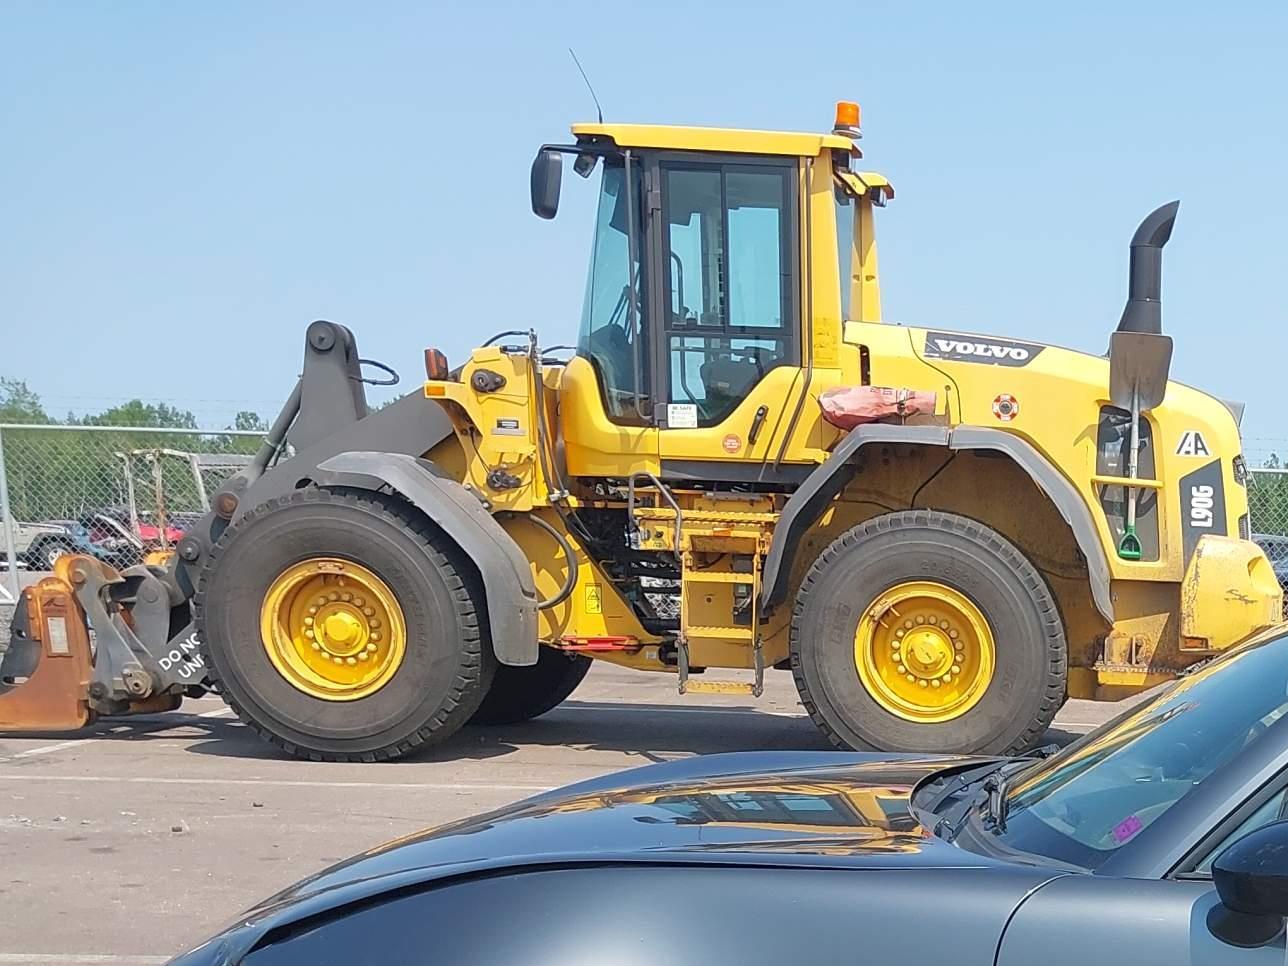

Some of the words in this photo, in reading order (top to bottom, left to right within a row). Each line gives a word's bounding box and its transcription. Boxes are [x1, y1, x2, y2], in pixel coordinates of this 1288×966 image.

[934, 339, 1029, 360] VOLVO
[1190, 485, 1214, 528] L90G
[159, 650, 182, 671] DO
